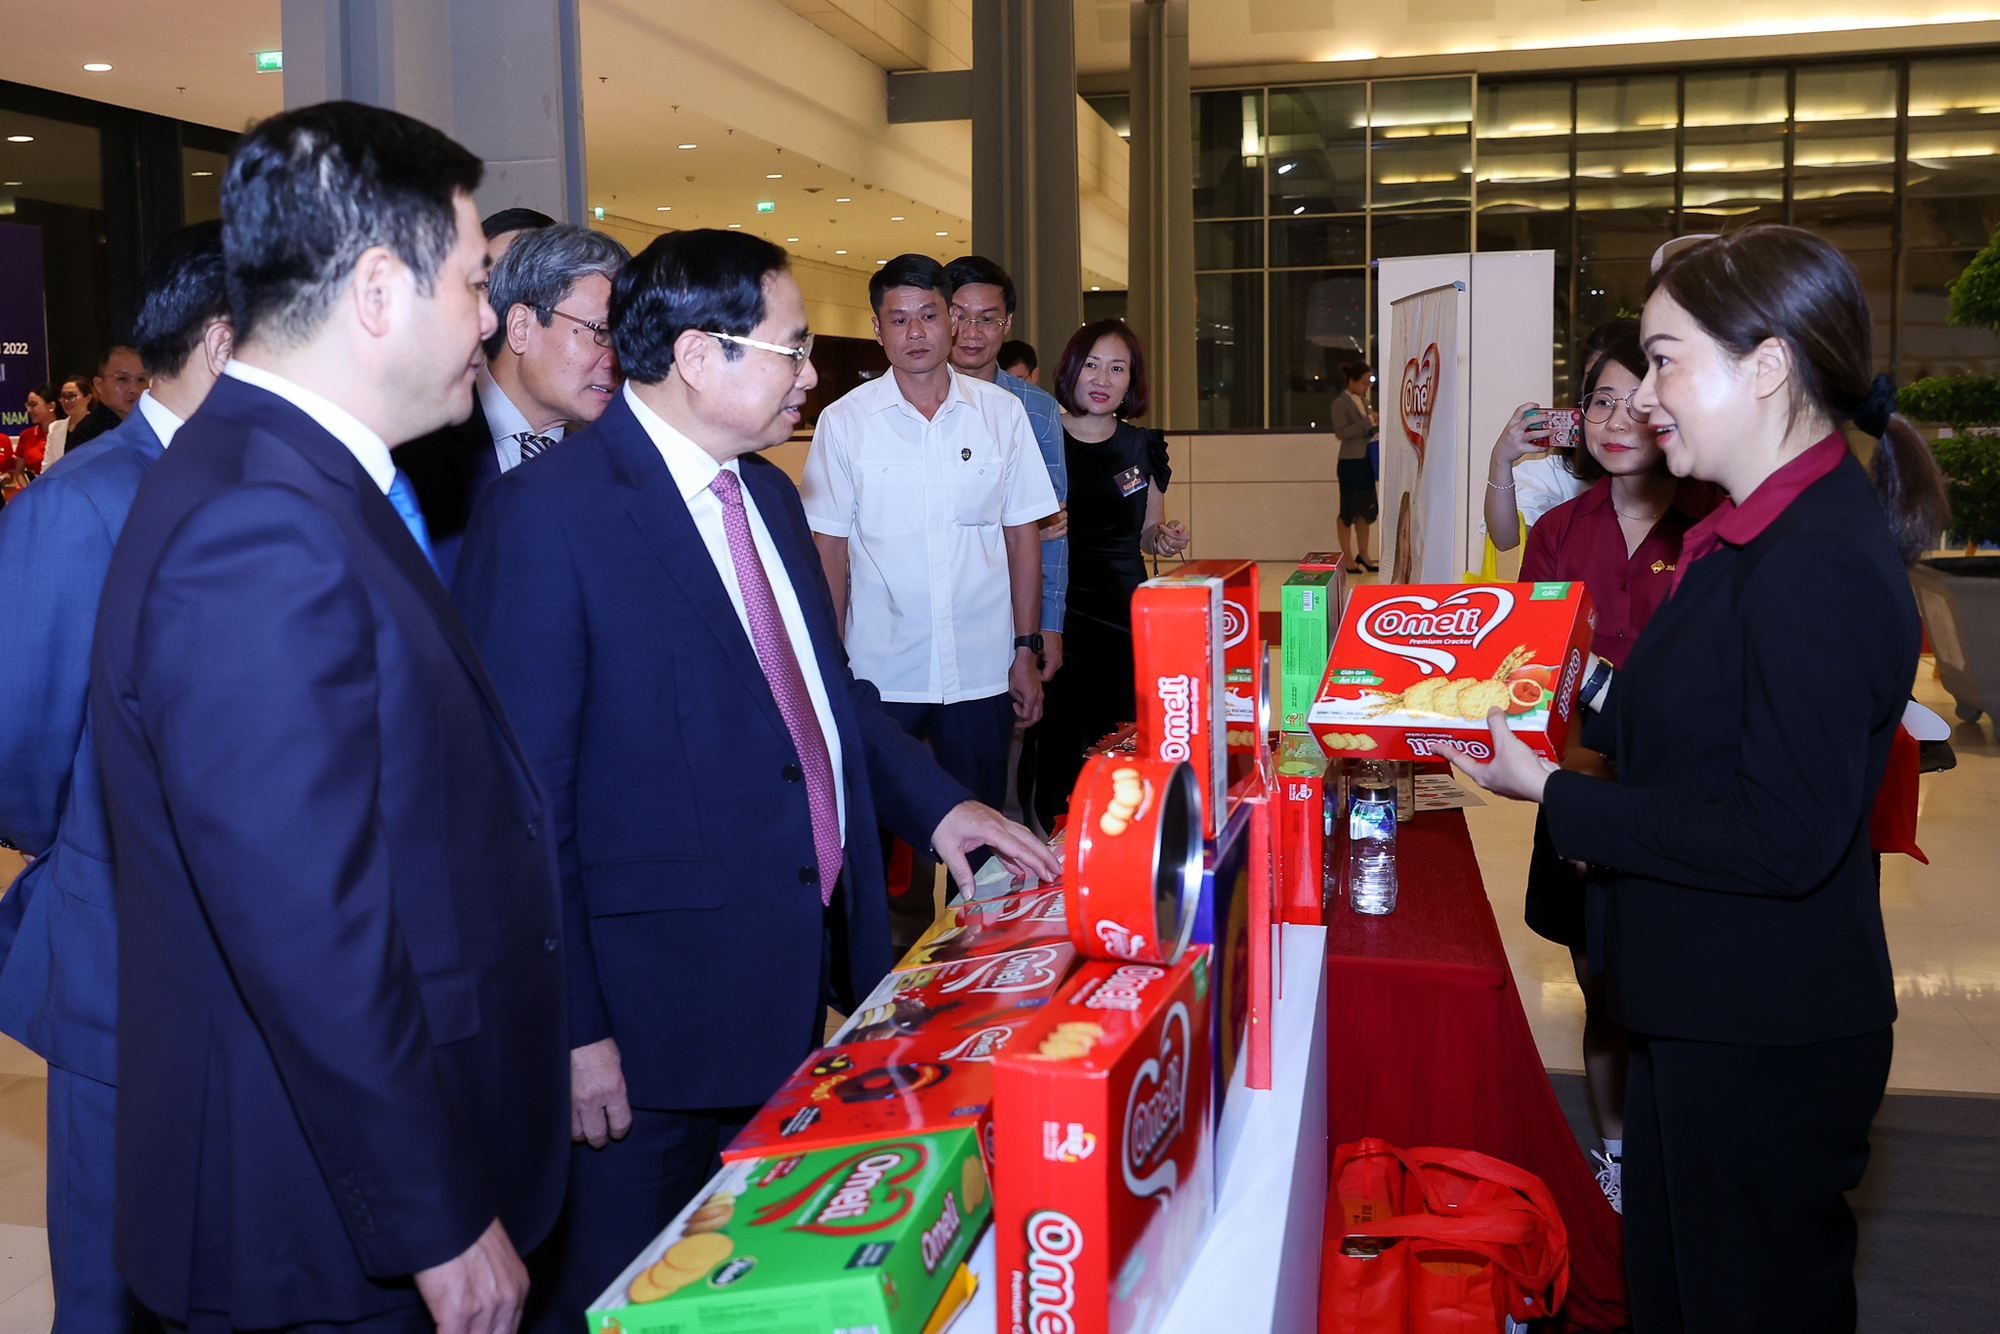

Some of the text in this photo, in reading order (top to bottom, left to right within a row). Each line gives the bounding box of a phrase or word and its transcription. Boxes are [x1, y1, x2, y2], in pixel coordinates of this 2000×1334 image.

[3, 342, 28, 354] 2022
[2, 411, 29, 425] NAM
[1373, 608, 1482, 636] Omeli
[1408, 638, 1473, 646] Premium Cracker
[1557, 647, 1581, 722] Omeli
[1158, 674, 1191, 762] Omeli
[1085, 964, 1165, 1011] Omeli
[817, 1153, 902, 1224] Omeli
[921, 1189, 961, 1273] Omeli
[1011, 1269, 1024, 1324] Premium
